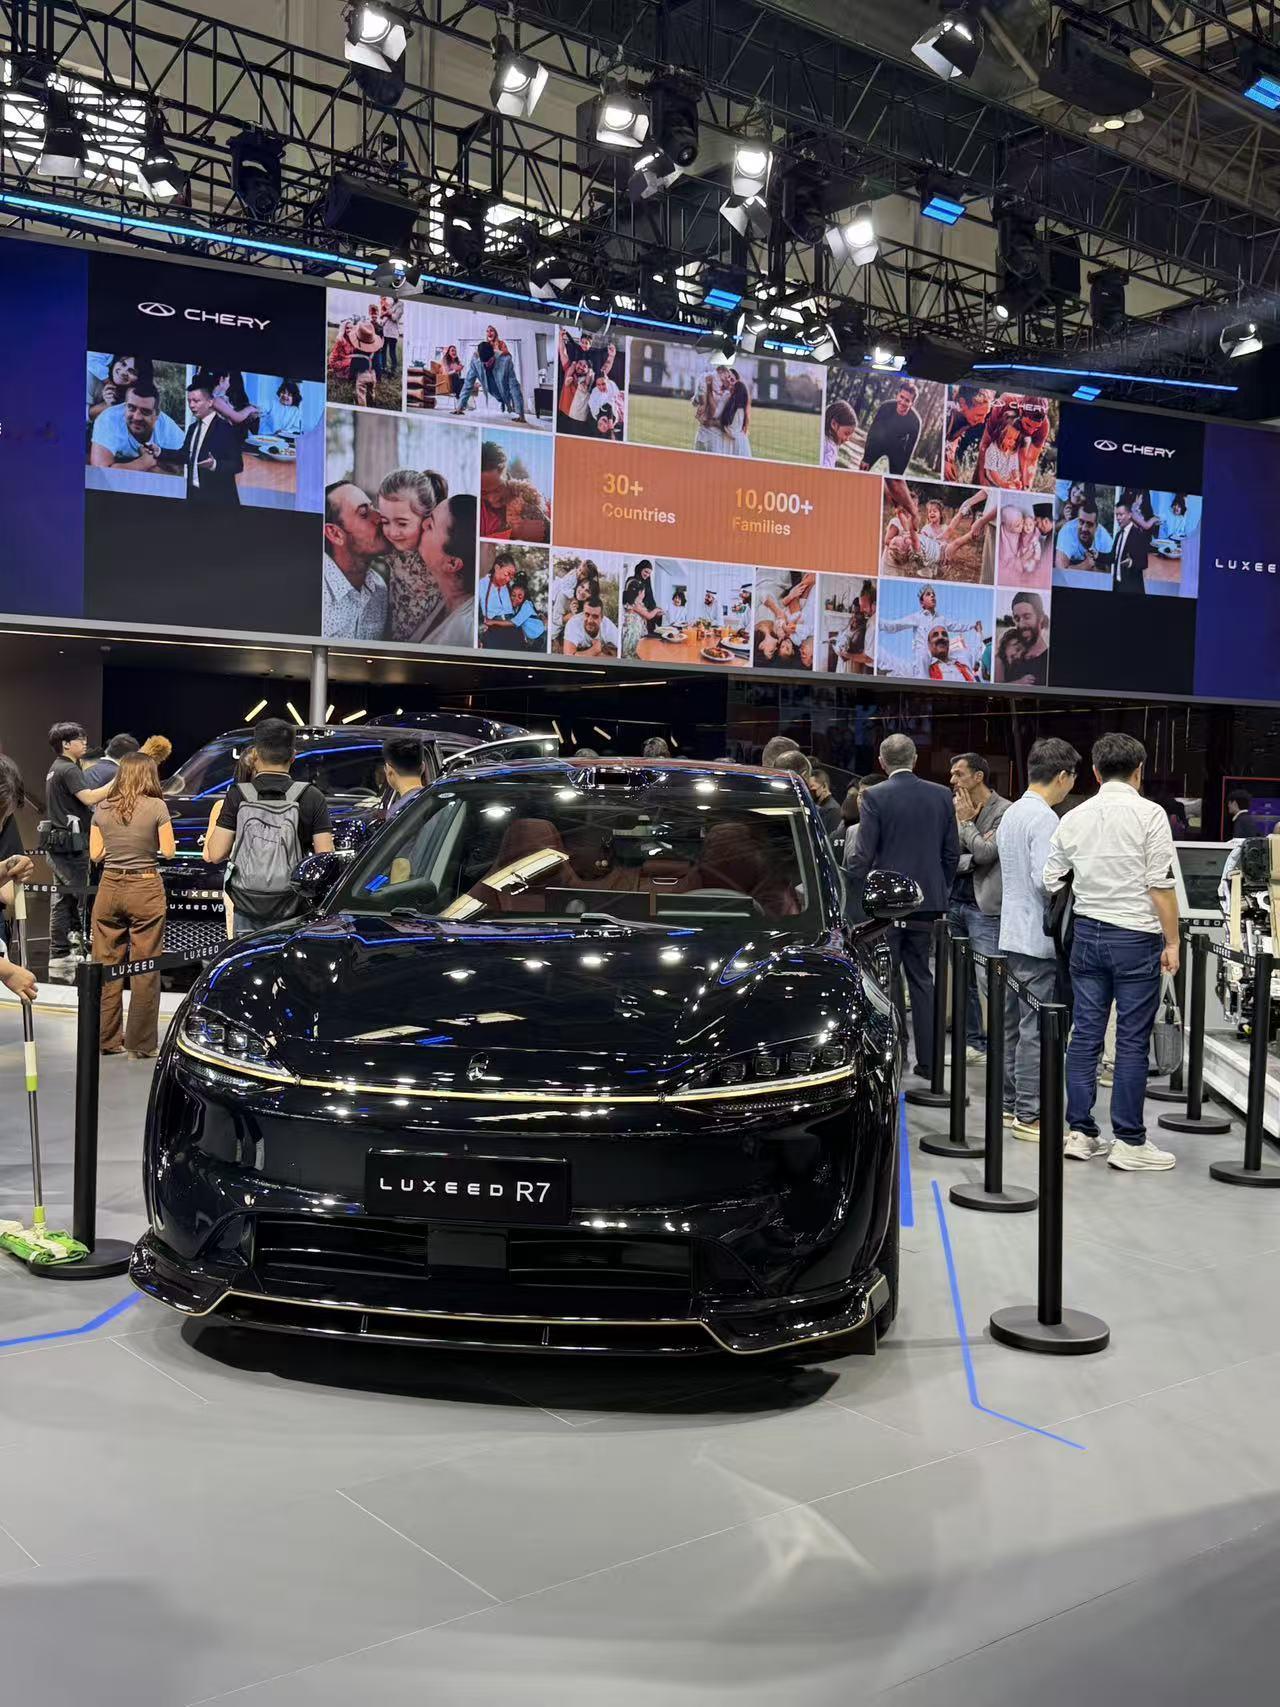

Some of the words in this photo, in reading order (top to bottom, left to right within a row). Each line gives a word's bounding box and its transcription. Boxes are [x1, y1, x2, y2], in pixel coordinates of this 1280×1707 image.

[184, 308, 271, 331] CHERY
[1008, 401, 1049, 413] CHERY
[1122, 443, 1176, 458] CHERY
[602, 473, 644, 497] 30+
[735, 487, 814, 516] 10,000+
[602, 502, 676, 524] Countries
[732, 516, 791, 536] Families
[1215, 558, 1277, 574] LUXEE
[833, 838, 845, 847] ST
[24, 884, 57, 892] XEED
[171, 889, 220, 898] LUXEE
[167, 903, 208, 911] UXEED
[211, 903, 224, 913] V9
[1181, 918, 1221, 926] XEED
[183, 944, 220, 961] LUXEED
[112, 959, 155, 977] LUXEED
[379, 1177, 504, 1197] LUXEED
[516, 1181, 551, 1203] R7
